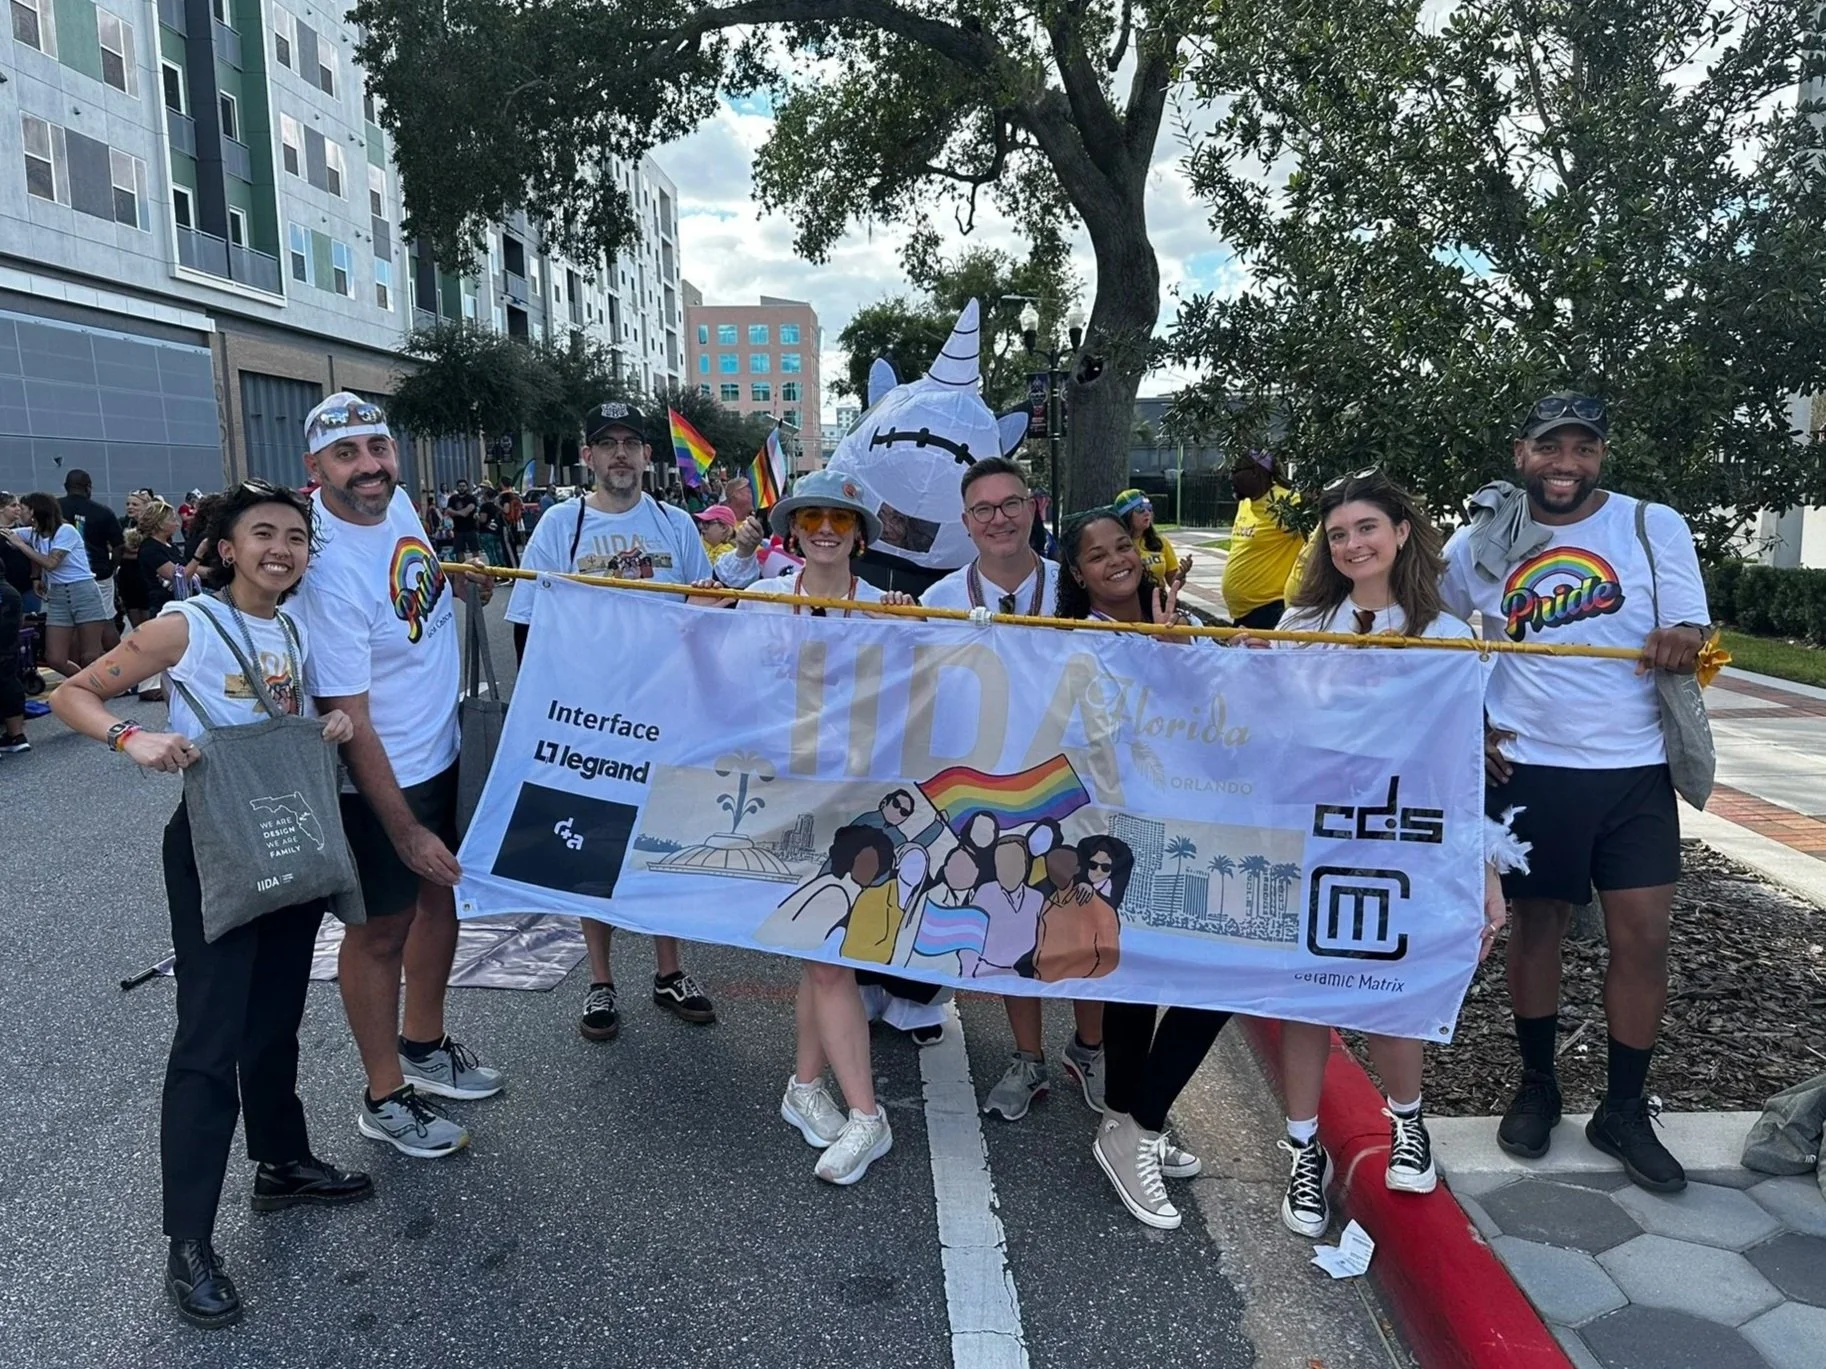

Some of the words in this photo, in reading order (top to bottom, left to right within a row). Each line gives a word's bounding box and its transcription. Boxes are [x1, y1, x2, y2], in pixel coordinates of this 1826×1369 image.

[1500, 575, 1625, 642] Pride
[547, 699, 660, 742] Interface
[788, 640, 1126, 807] IIDA
[1086, 671, 1251, 747] Florida
[558, 744, 651, 784] legrand
[1170, 776, 1253, 795] ORLANDO
[260, 821, 273, 829] WE
[276, 817, 292, 825] ARE
[263, 826, 295, 838] DESIGN
[266, 839, 280, 849] WE
[282, 835, 298, 845] ARE
[270, 845, 301, 858] FAMILY
[257, 876, 280, 892] IIDA
[1358, 974, 1406, 993] Matrix
